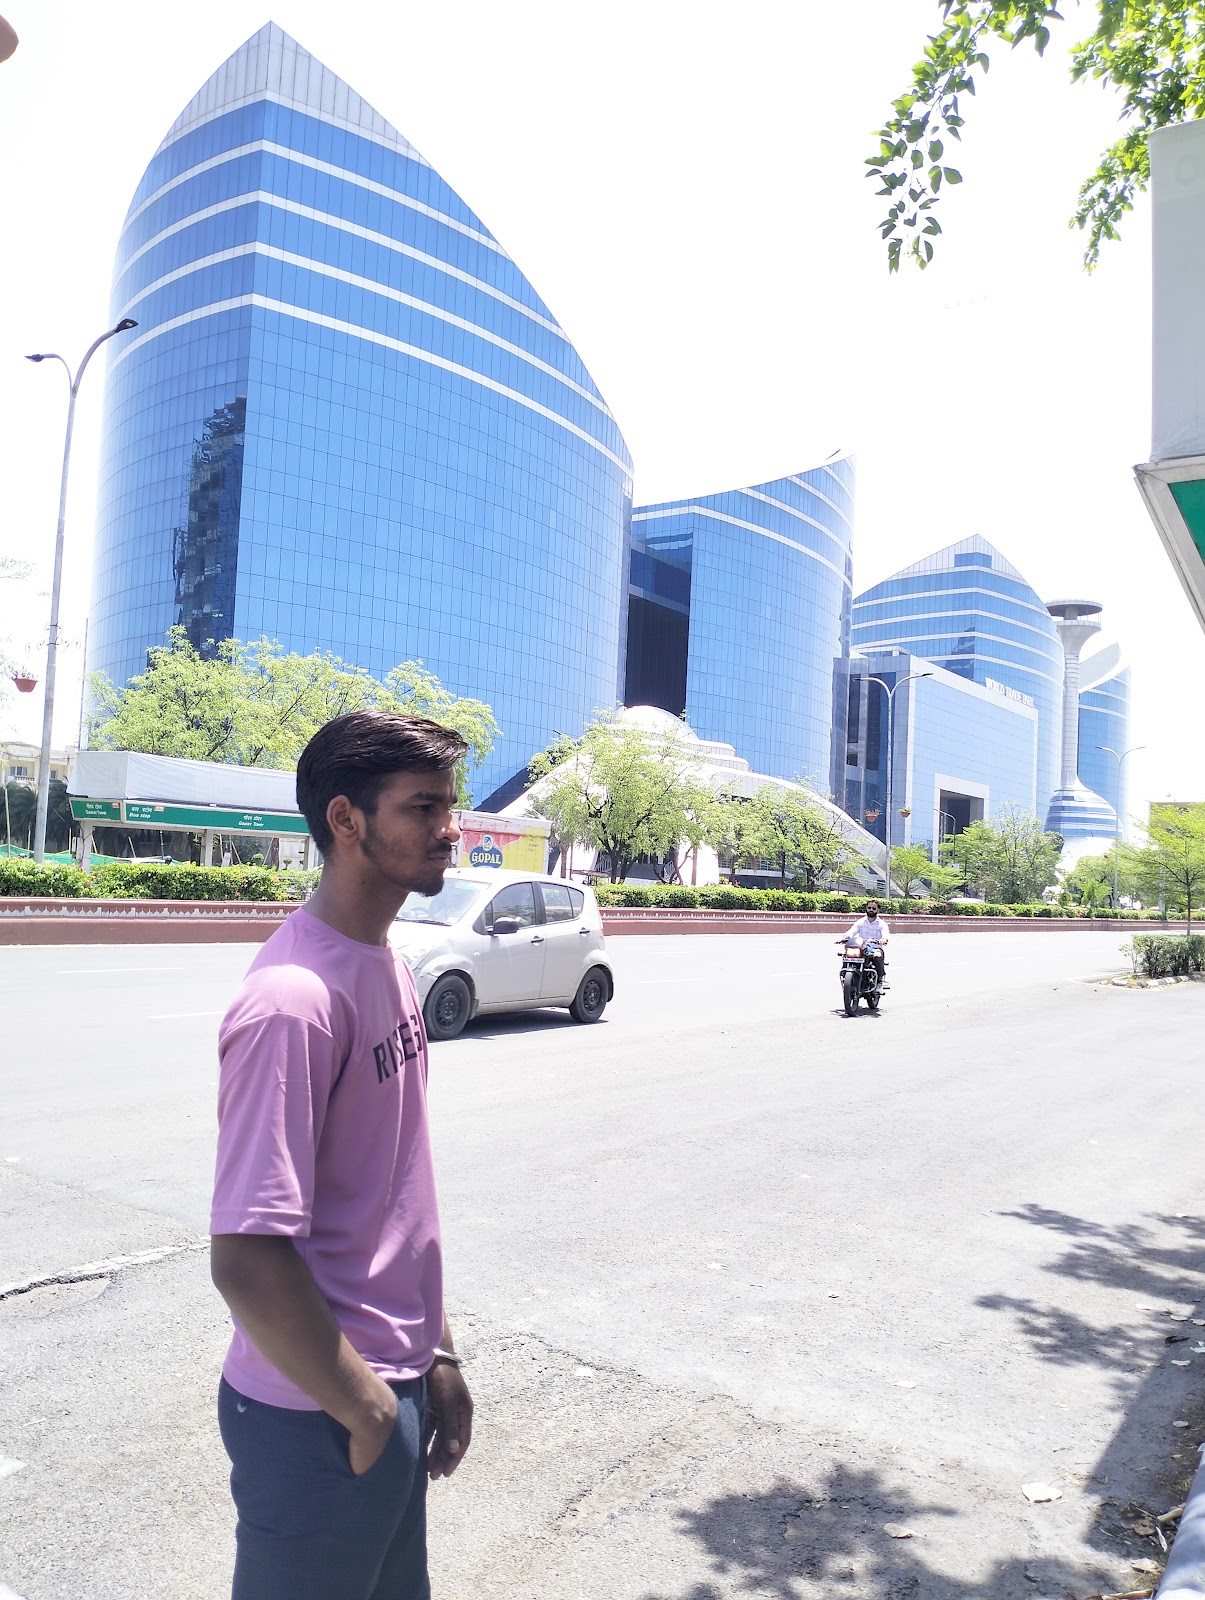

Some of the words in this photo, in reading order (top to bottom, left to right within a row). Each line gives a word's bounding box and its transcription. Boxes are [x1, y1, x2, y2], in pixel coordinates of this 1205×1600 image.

[985, 676, 1005, 695] WORLD
[1005, 686, 1023, 703] TRADE
[471, 851, 501, 864] GOPAL
